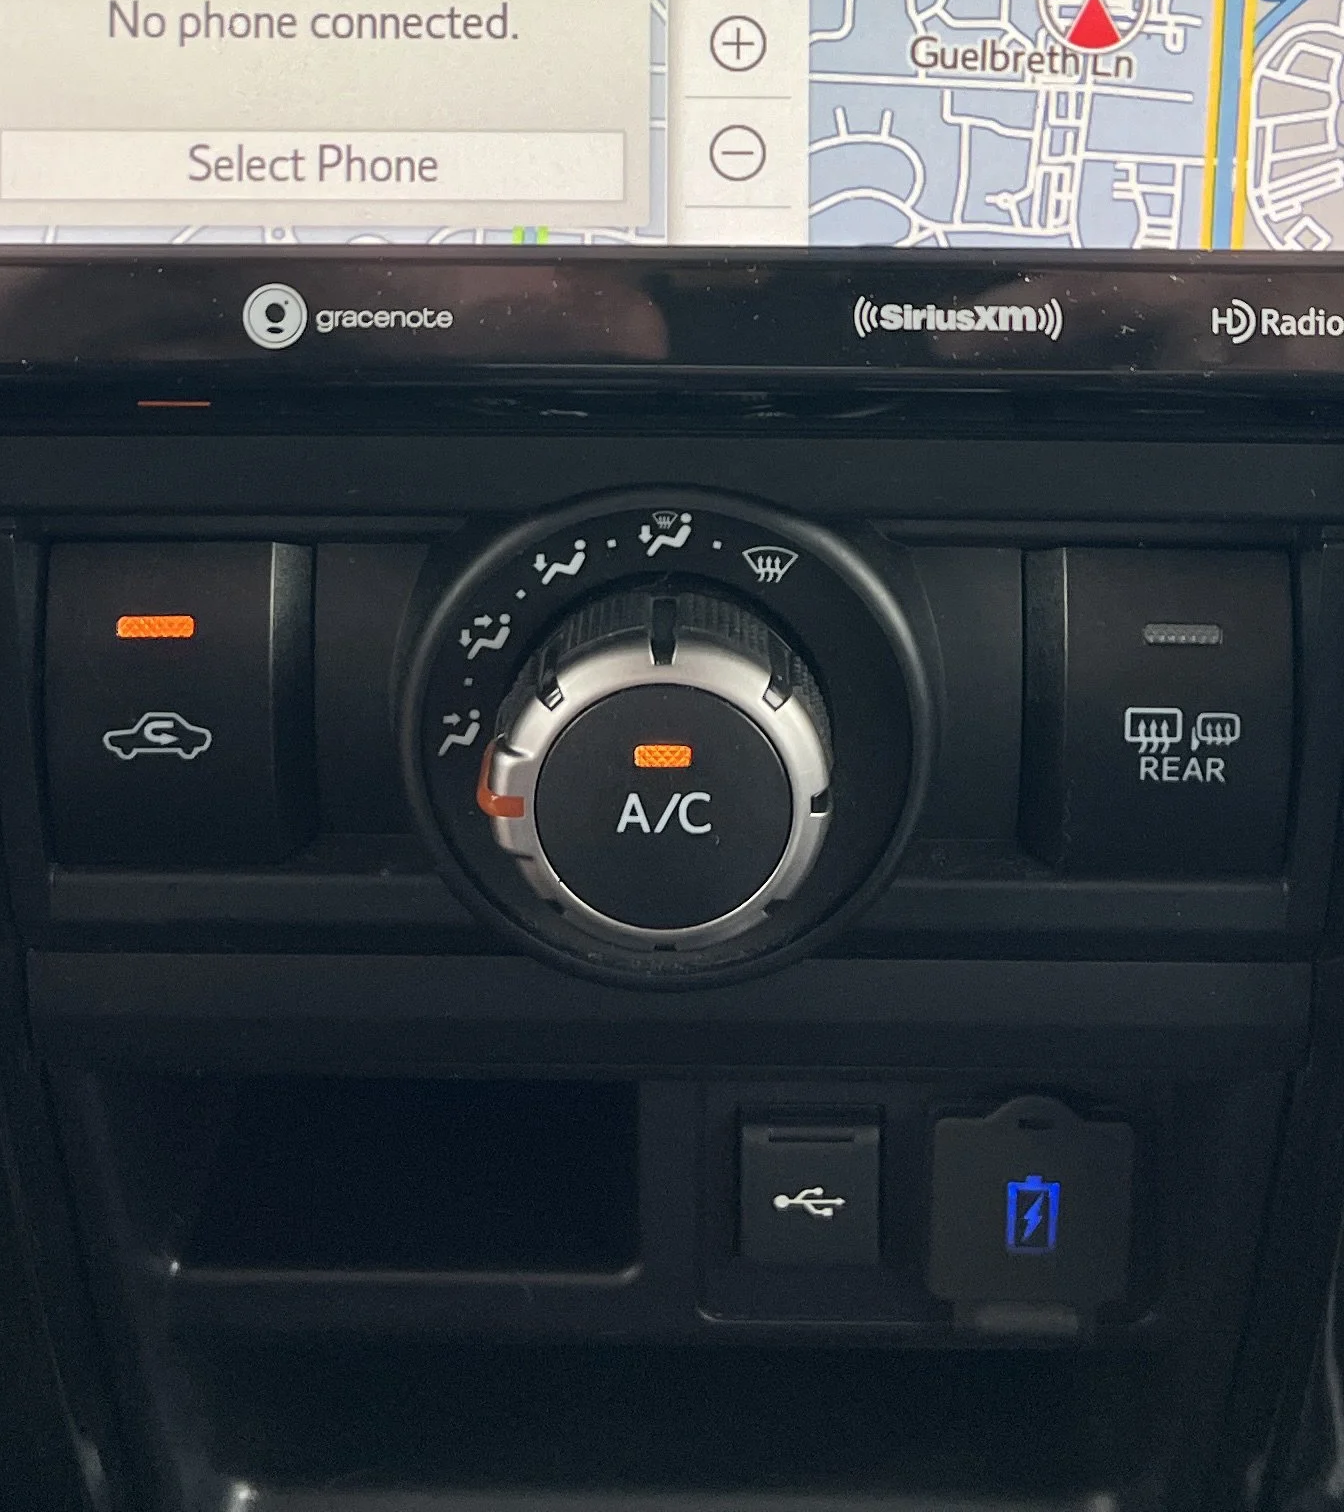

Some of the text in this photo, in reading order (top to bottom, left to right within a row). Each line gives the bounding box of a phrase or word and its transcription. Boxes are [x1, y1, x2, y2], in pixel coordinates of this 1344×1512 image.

[108, 0, 519, 47] No phone connected.
[911, 36, 1133, 79] Guelbreth Ln
[188, 144, 438, 183] Select Phone
[316, 307, 454, 333] gracenote
[1140, 756, 1226, 782] REAR
[616, 791, 713, 834] A/C
